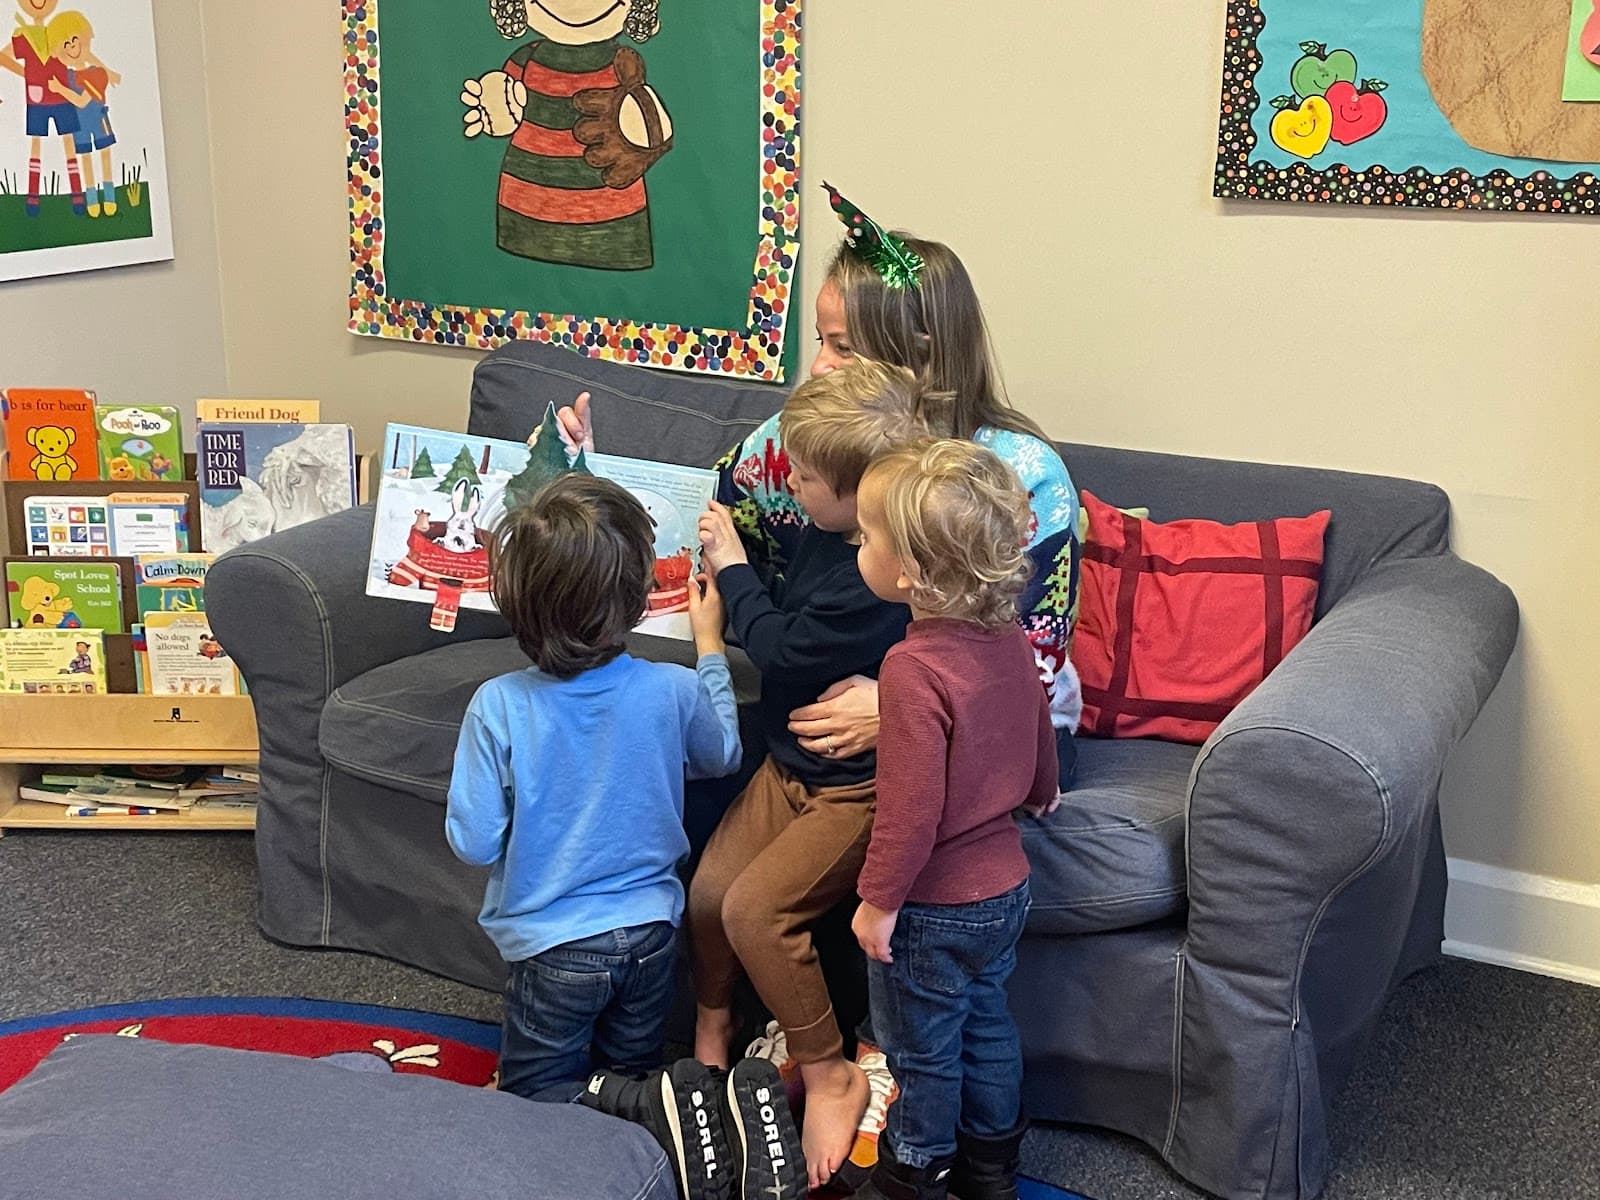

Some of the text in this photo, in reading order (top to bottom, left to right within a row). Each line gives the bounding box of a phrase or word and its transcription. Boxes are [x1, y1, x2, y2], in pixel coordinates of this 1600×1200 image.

[9, 398, 88, 411] b is for bear
[215, 407, 301, 422] Friend Dog
[110, 417, 134, 431] Pooh
[204, 433, 242, 450] TIME
[207, 451, 239, 469] FOR
[208, 469, 239, 486] BED
[54, 569, 110, 581] Spot Loves
[76, 583, 111, 594] School
[155, 632, 191, 643] No dogs
[156, 642, 190, 652] allowed
[691, 1090, 717, 1179] SOREL
[756, 1087, 786, 1174] SOREL
